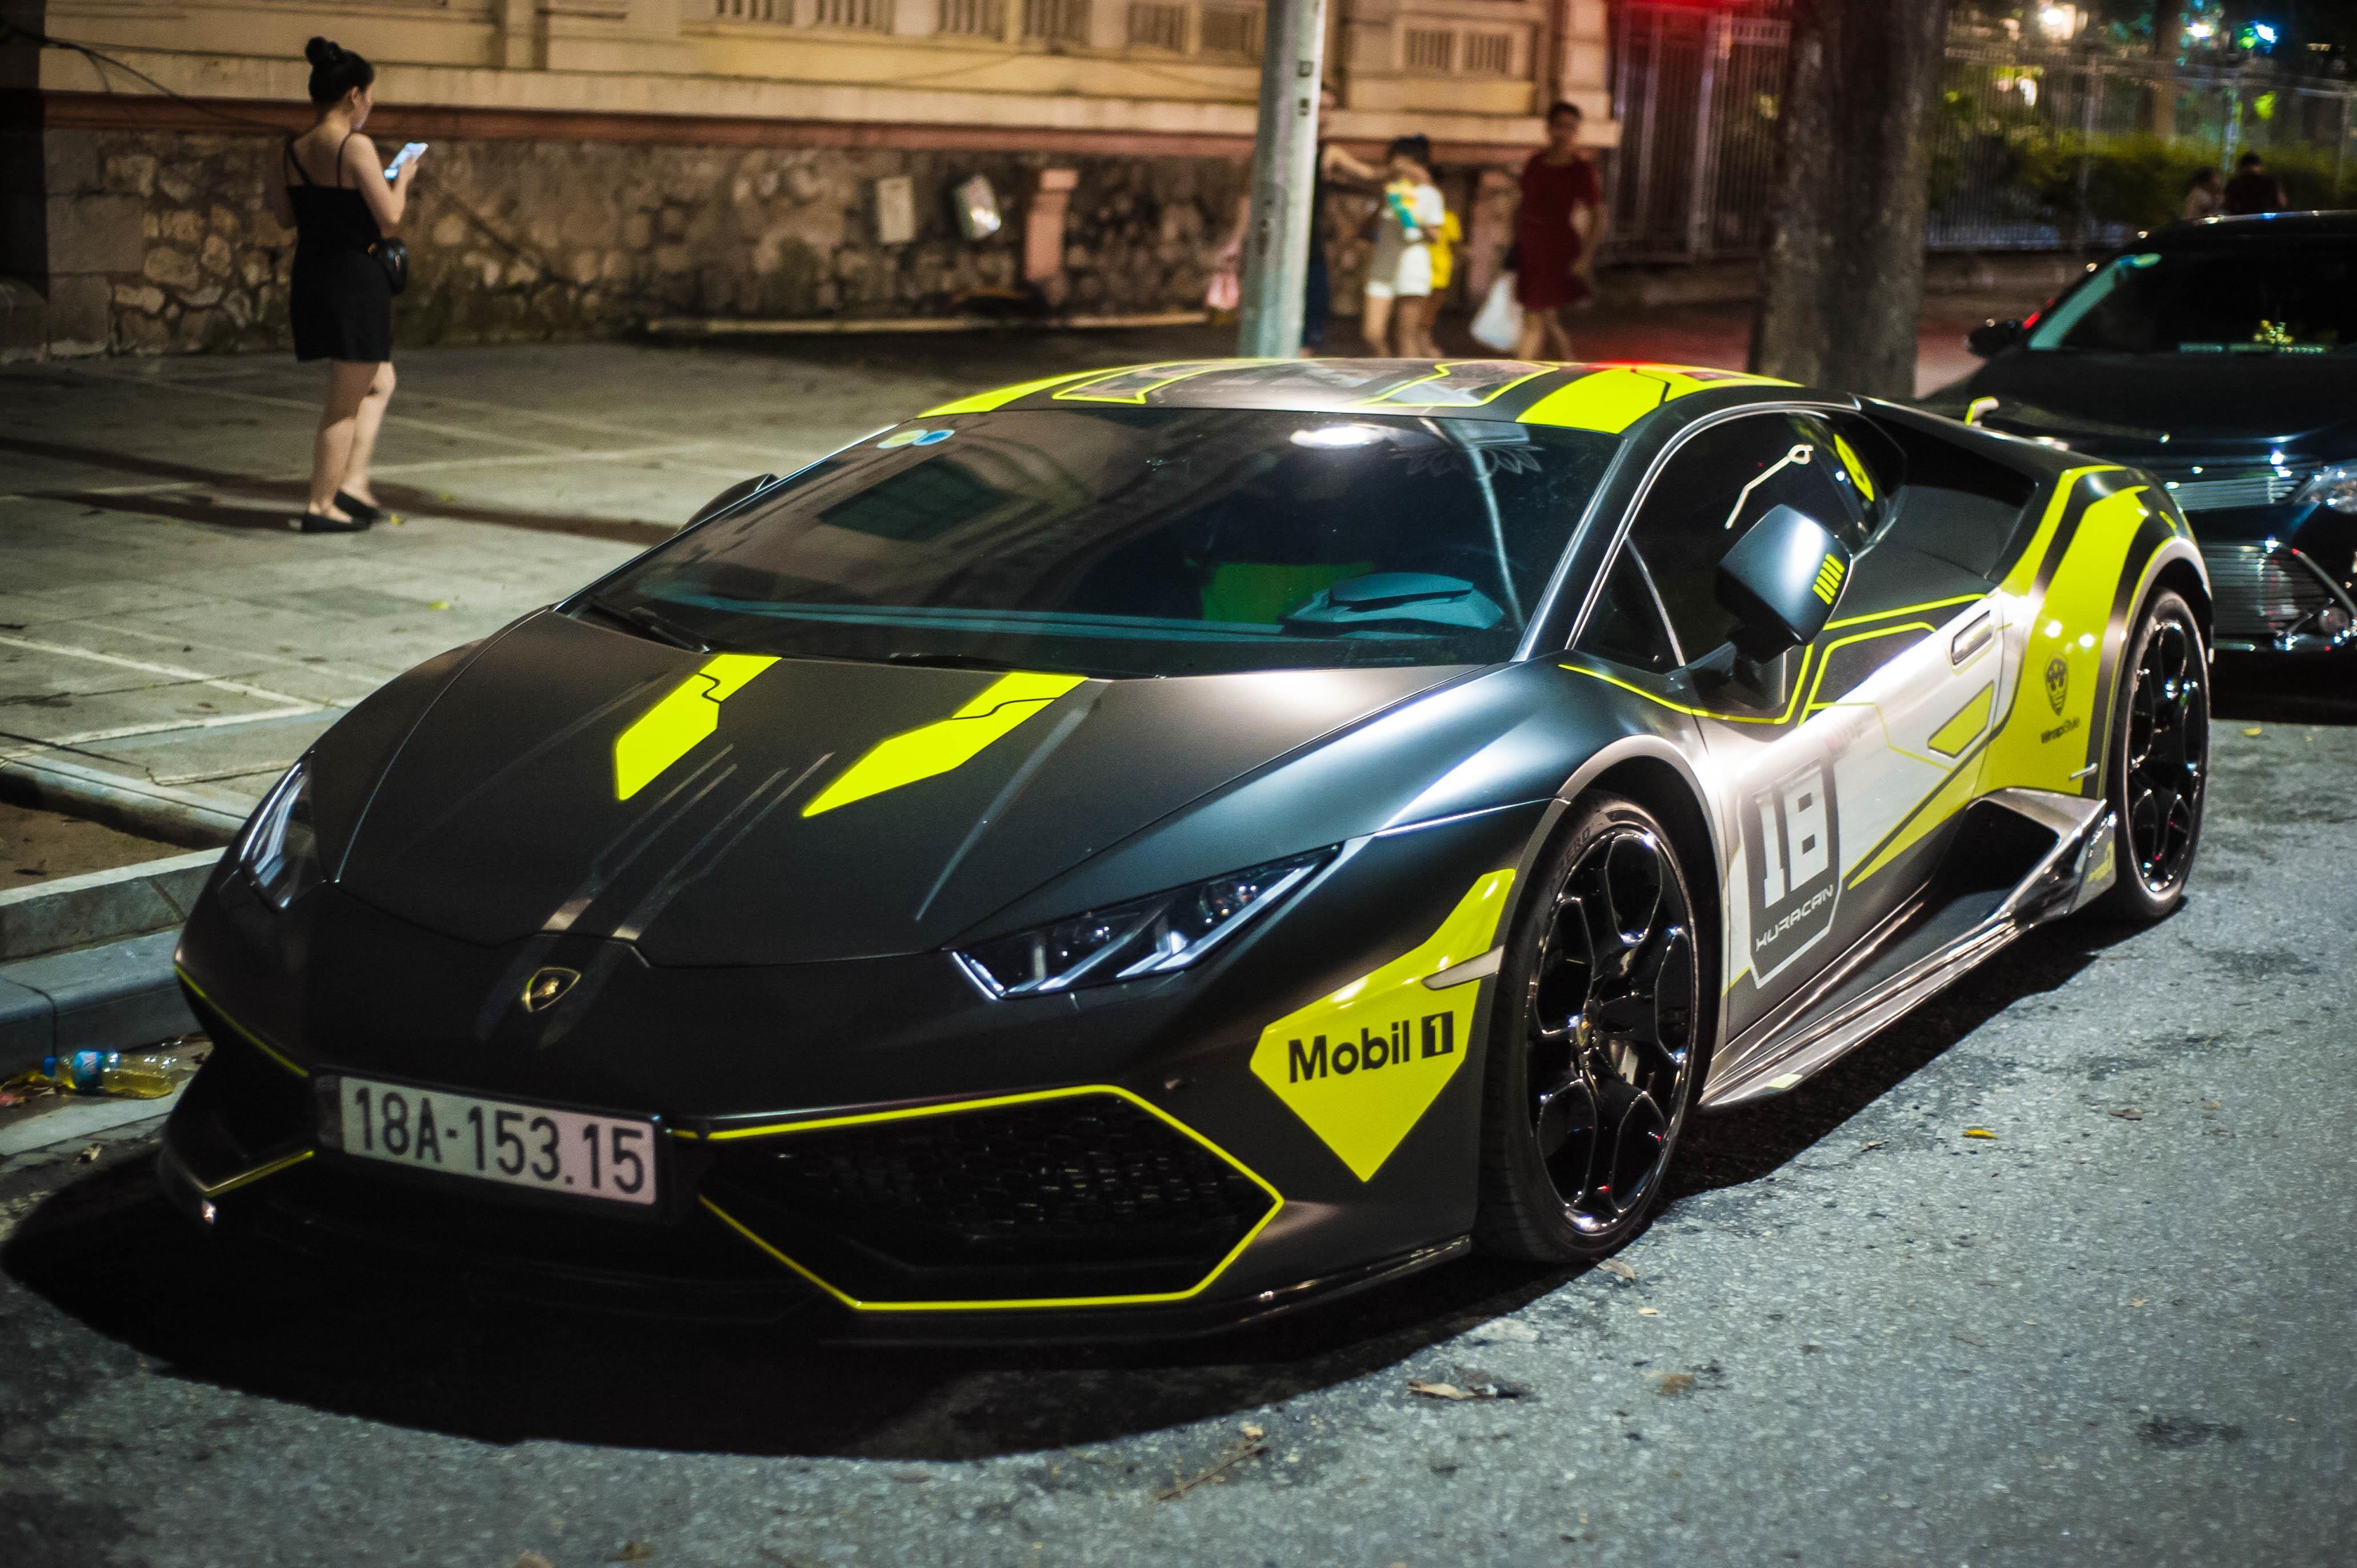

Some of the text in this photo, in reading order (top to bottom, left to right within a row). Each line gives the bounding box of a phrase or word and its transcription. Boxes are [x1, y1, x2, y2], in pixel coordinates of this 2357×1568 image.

[1756, 763, 1829, 909] 18
[1755, 884, 1834, 952] HURACAN
[1288, 1020, 1411, 1084] Mobil
[354, 1086, 645, 1195] 18A-153.15
